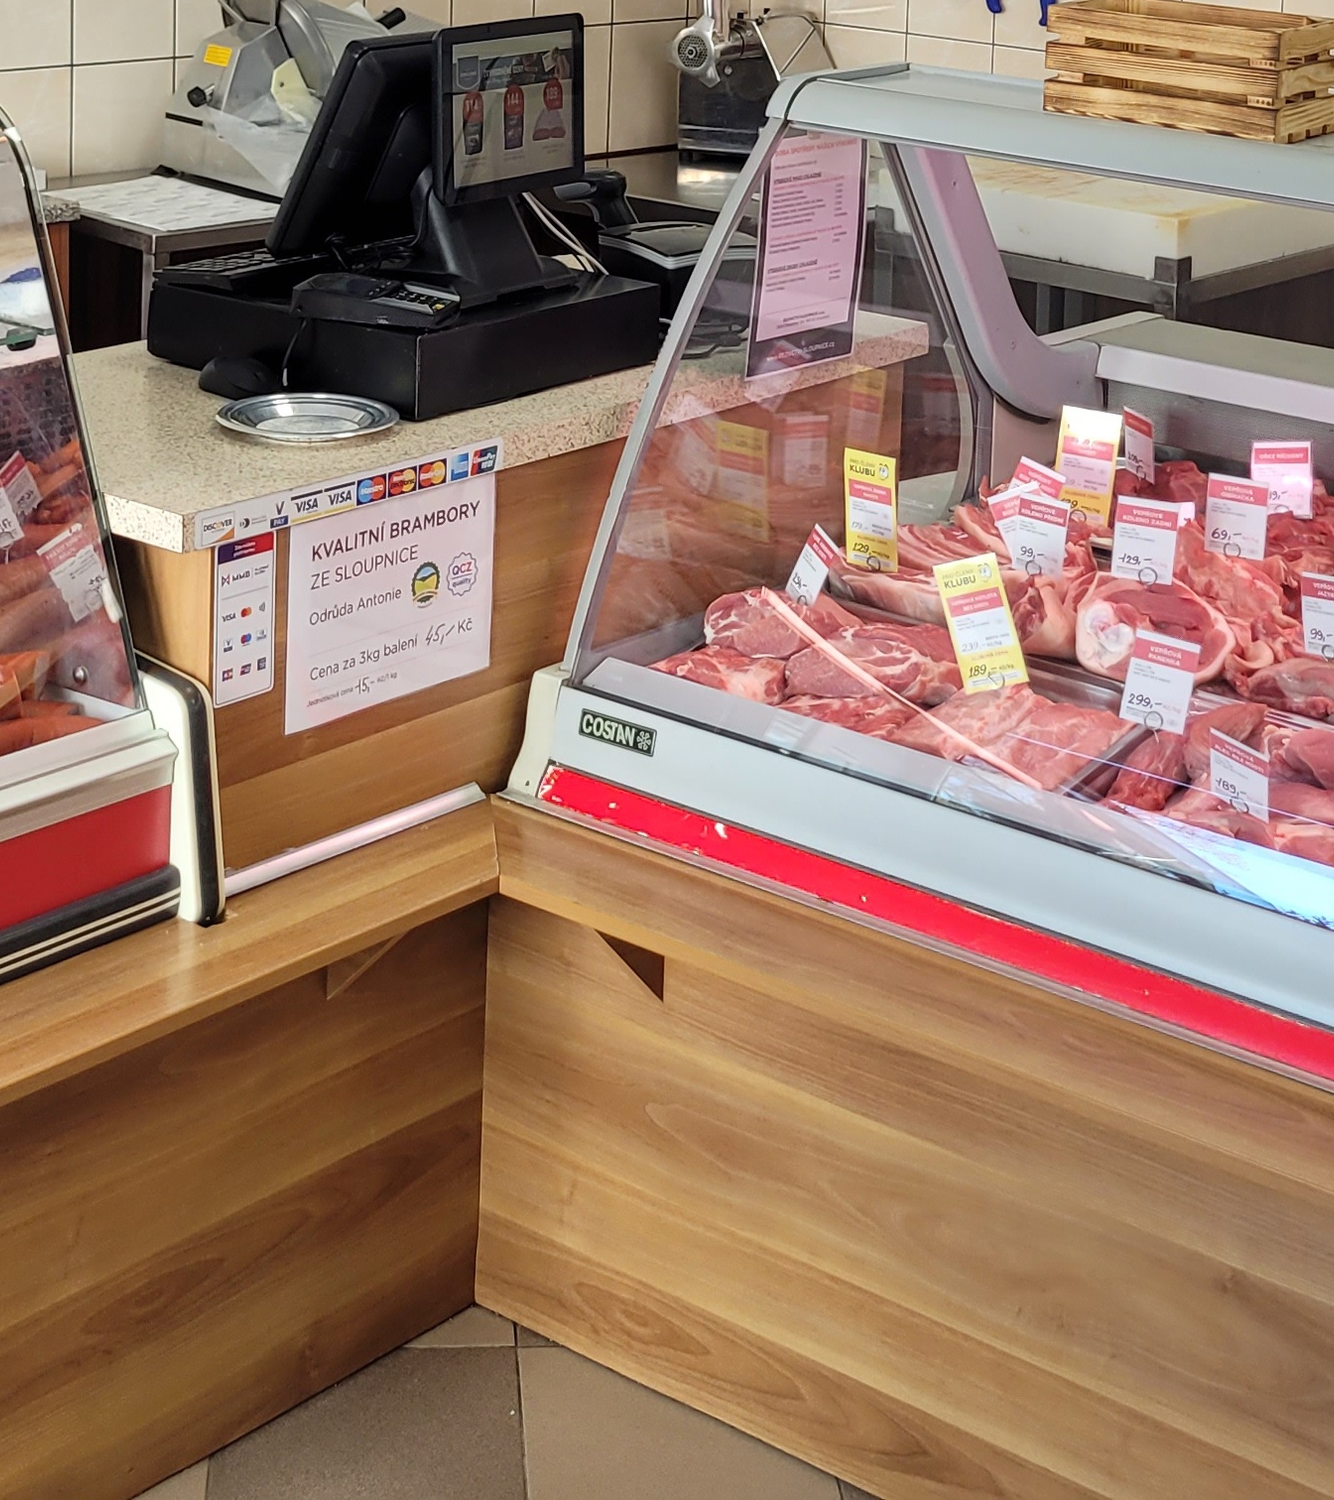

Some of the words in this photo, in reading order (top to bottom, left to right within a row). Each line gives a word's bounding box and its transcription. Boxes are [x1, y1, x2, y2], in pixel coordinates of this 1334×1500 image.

[849, 464, 876, 477] KLUBU
[275, 501, 285, 516] V
[295, 498, 320, 513] VISA
[328, 489, 353, 506] VISA
[203, 517, 234, 534] DISCOVER
[273, 516, 287, 527] PAY
[1122, 514, 1150, 526] KOLENO
[311, 521, 385, 561] KVALITNÍ
[389, 500, 481, 539] BRAMBORY
[1211, 527, 1243, 541] 69,-
[1020, 546, 1045, 559] 99,-
[310, 570, 330, 591] ZE
[334, 544, 418, 583] SLOUPNICE
[452, 561, 473, 576] QCZ
[232, 569, 251, 583] MMB
[943, 575, 977, 589] KLUBU
[309, 601, 354, 626] Odrůda
[357, 588, 402, 612] Antonie
[221, 612, 237, 623] VISA
[1309, 628, 1334, 642] 99,-
[310, 660, 340, 682] Cena
[342, 655, 357, 671] za
[359, 646, 381, 669] 3kg
[383, 633, 418, 656] balení
[457, 617, 473, 635] Kč
[1127, 692, 1163, 709] 299,-
[582, 713, 636, 747] COSTAN
